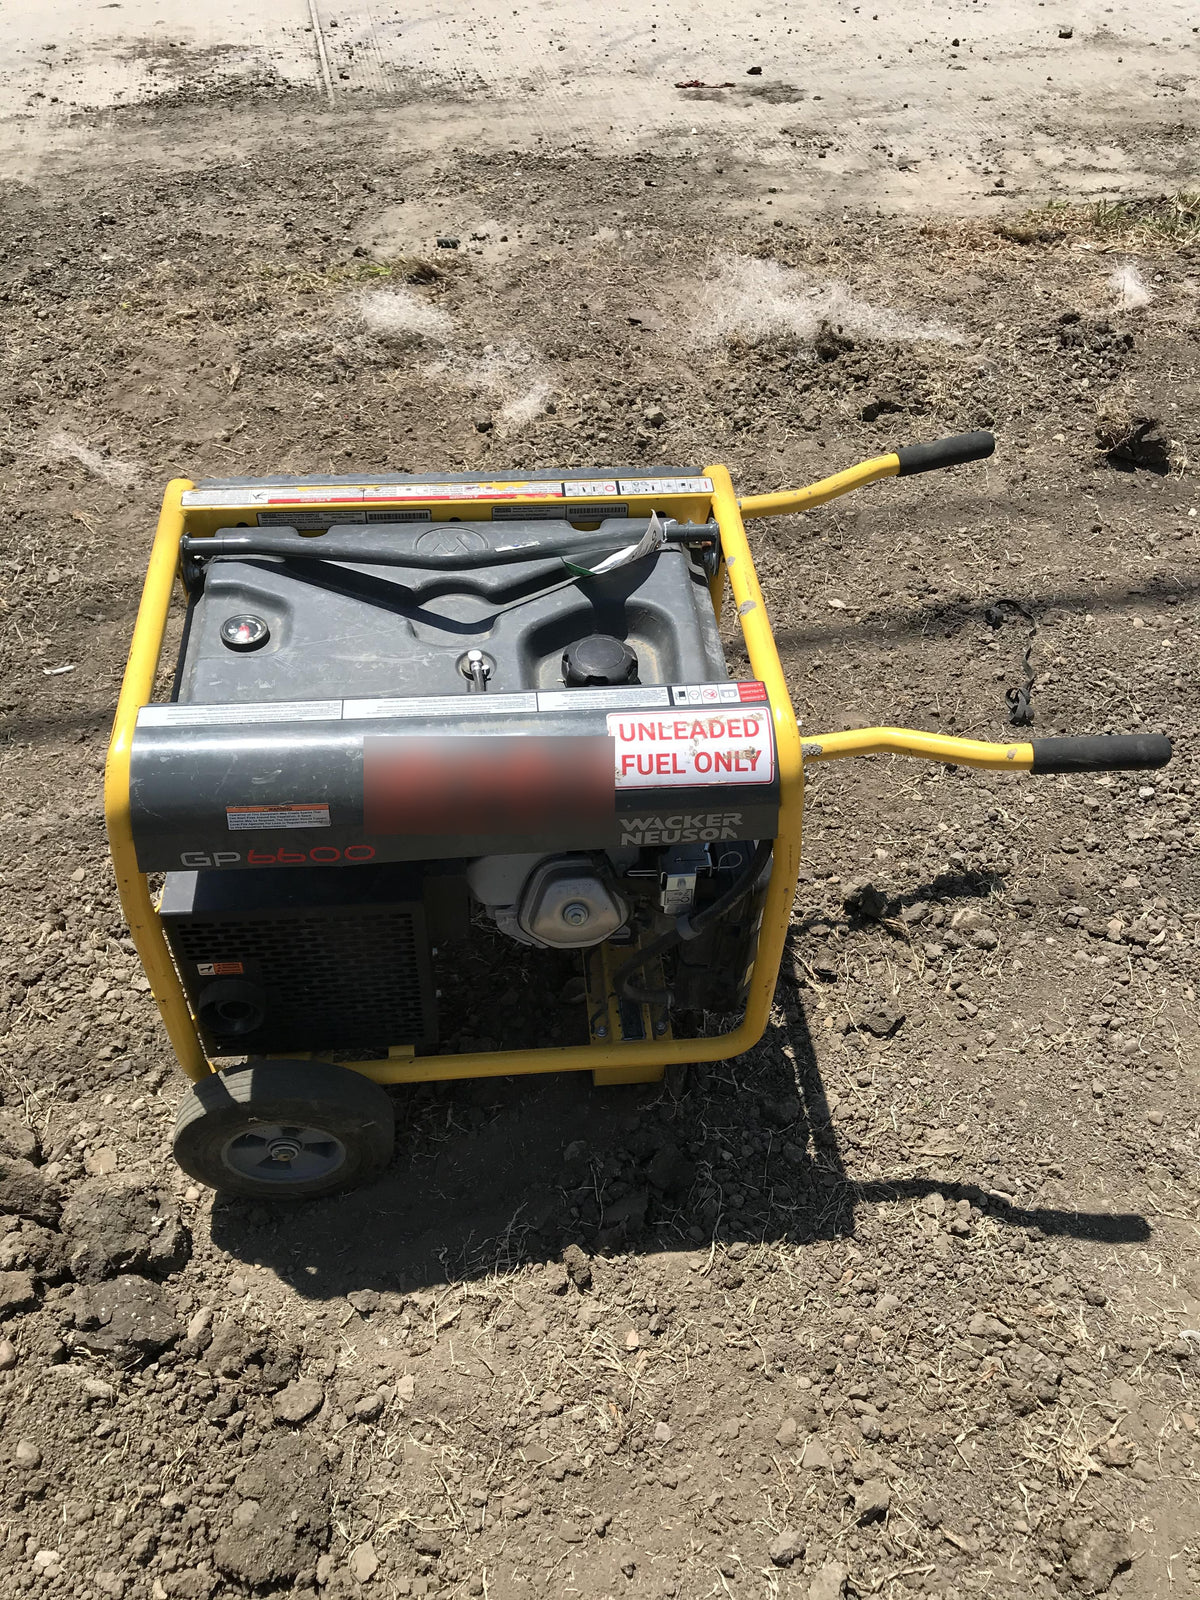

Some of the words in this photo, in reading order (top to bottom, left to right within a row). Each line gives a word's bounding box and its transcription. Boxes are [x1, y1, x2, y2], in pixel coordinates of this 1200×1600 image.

[619, 718, 760, 742] UNLEADED
[621, 752, 686, 776] FUEL
[694, 750, 762, 774] ONLY
[620, 812, 743, 832] WACKER
[621, 826, 738, 846] NEUSON
